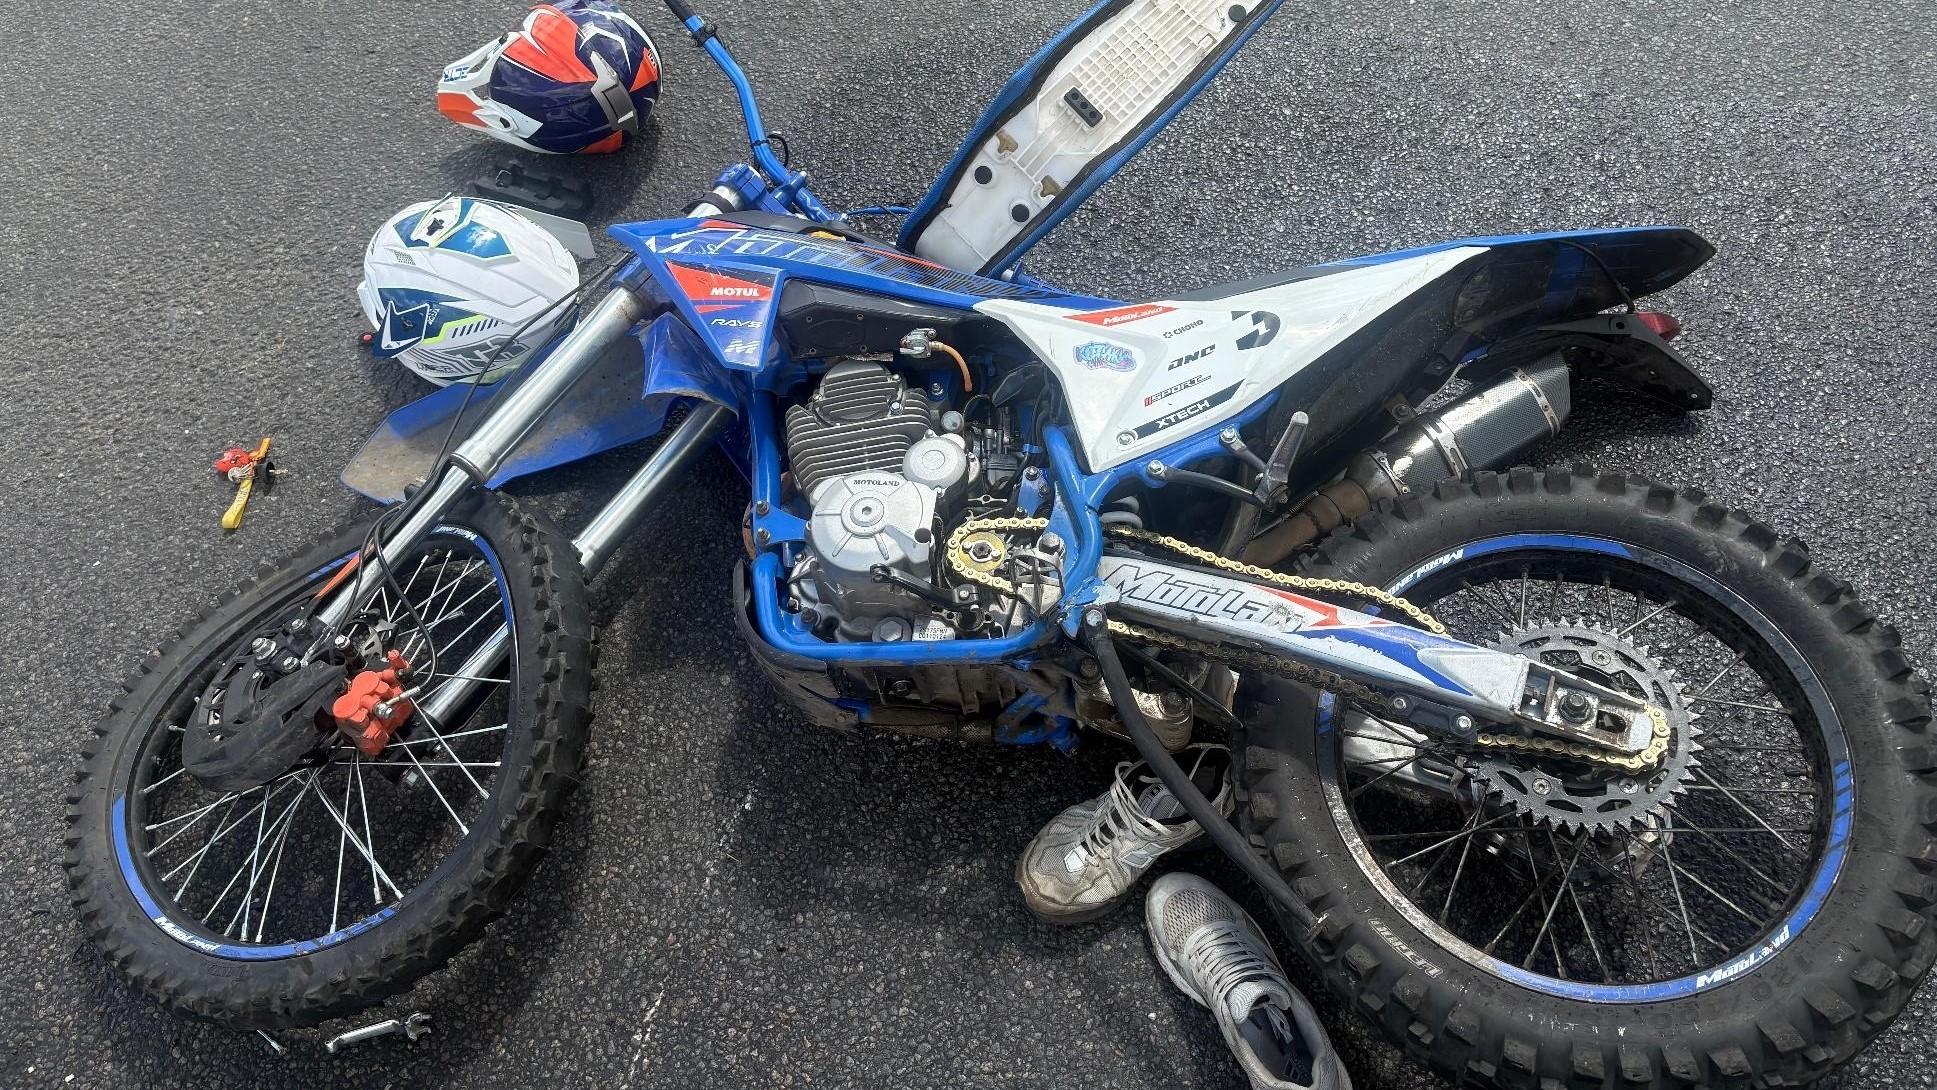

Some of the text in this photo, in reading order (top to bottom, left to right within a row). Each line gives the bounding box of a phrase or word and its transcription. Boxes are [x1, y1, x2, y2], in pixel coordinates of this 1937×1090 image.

[710, 287, 759, 297] MOTUL
[710, 318, 763, 329] RAYS
[1173, 319, 1204, 335] CHOHO
[1155, 399, 1211, 429] XTECH
[853, 479, 900, 487] MOTOLAND
